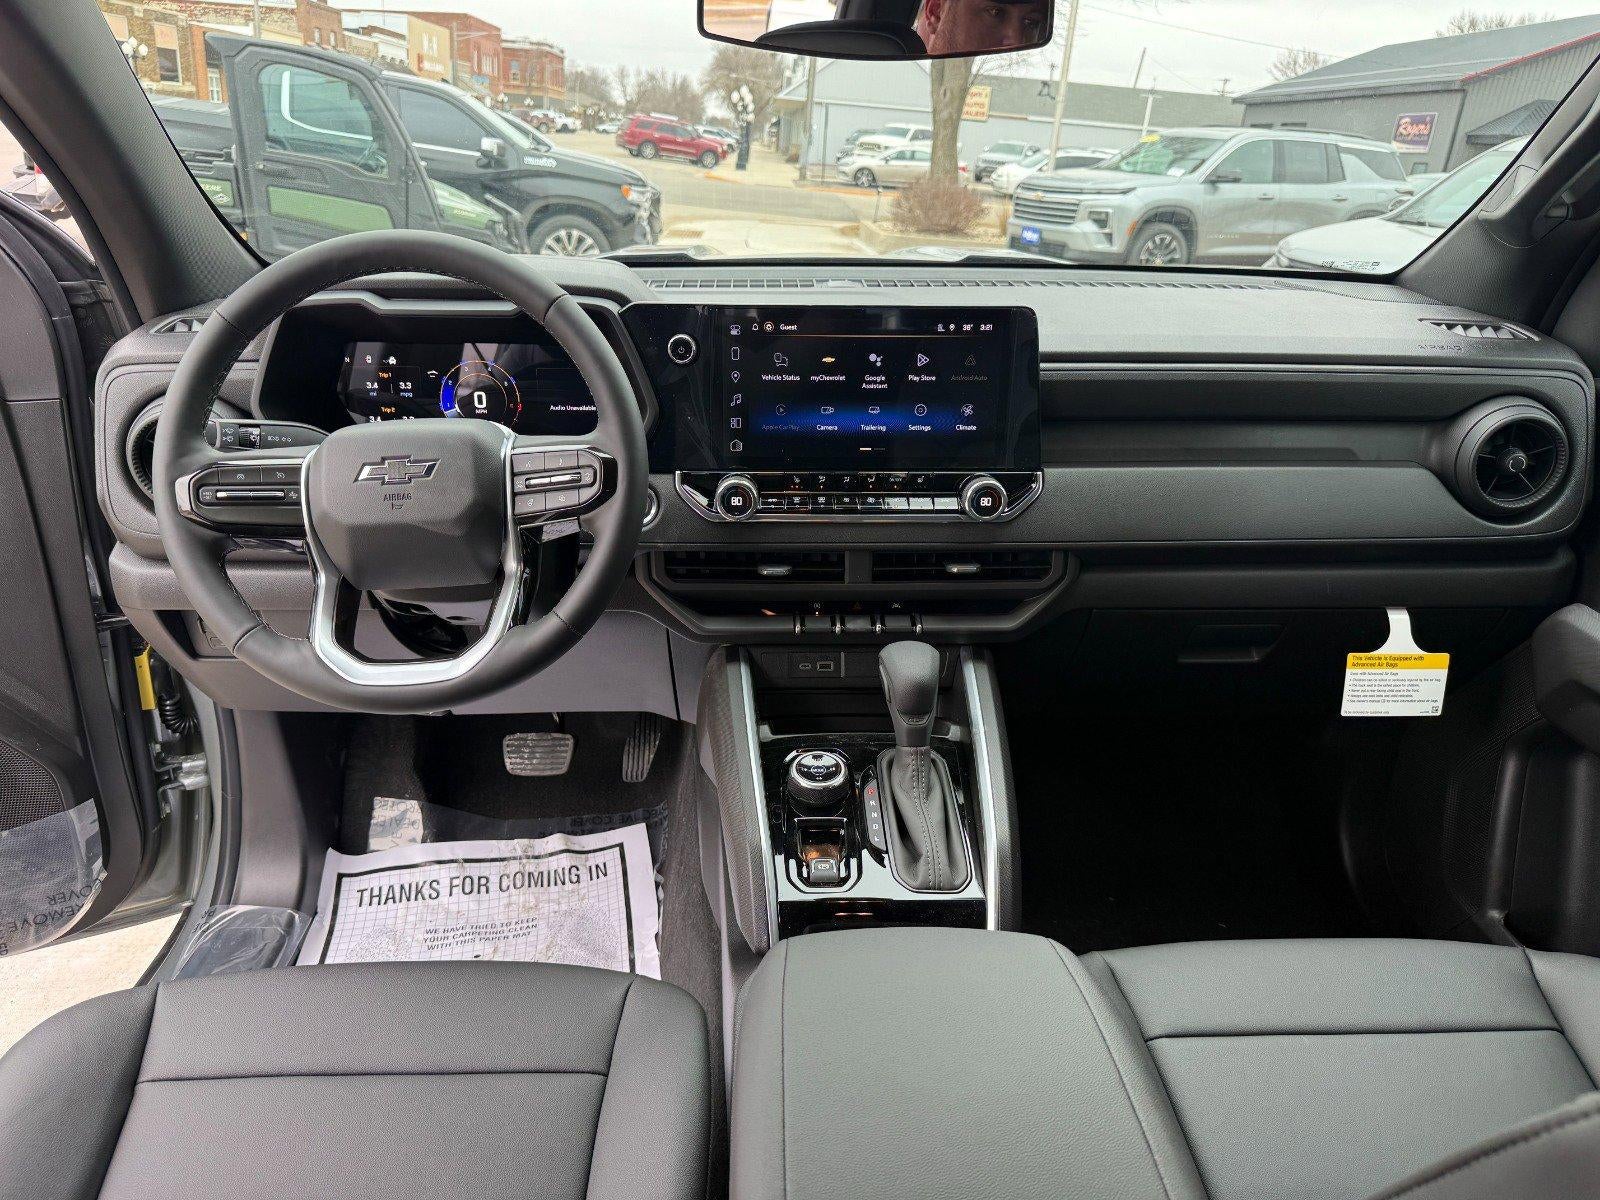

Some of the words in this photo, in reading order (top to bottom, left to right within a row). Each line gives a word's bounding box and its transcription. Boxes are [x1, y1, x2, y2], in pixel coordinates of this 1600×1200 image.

[780, 323, 798, 331] Guest
[810, 374, 846, 382] myChevrolet
[864, 374, 886, 382] Google
[908, 374, 920, 382] Play
[399, 381, 412, 389] 3.3
[473, 391, 487, 409] 0
[860, 424, 887, 432] Trailering
[908, 424, 932, 432] Settings
[383, 492, 412, 501] AIRBAG
[731, 496, 743, 505] 80
[980, 497, 992, 506] 80
[356, 878, 441, 908] THANKS
[448, 874, 490, 898] FOR
[498, 864, 582, 893] COMING
[588, 861, 609, 882] IN
[46, 883, 97, 906] OVER
[442, 924, 467, 934] HAVE
[470, 922, 497, 931] TRIED
[515, 917, 538, 926] KEEP
[423, 935, 450, 944] YOUR
[452, 929, 505, 940] CARPETING
[508, 923, 538, 933] CLEAN
[426, 943, 452, 951] WITH
[455, 937, 476, 946] THIS
[479, 934, 510, 943] PAPER
[512, 930, 532, 939] MAT
